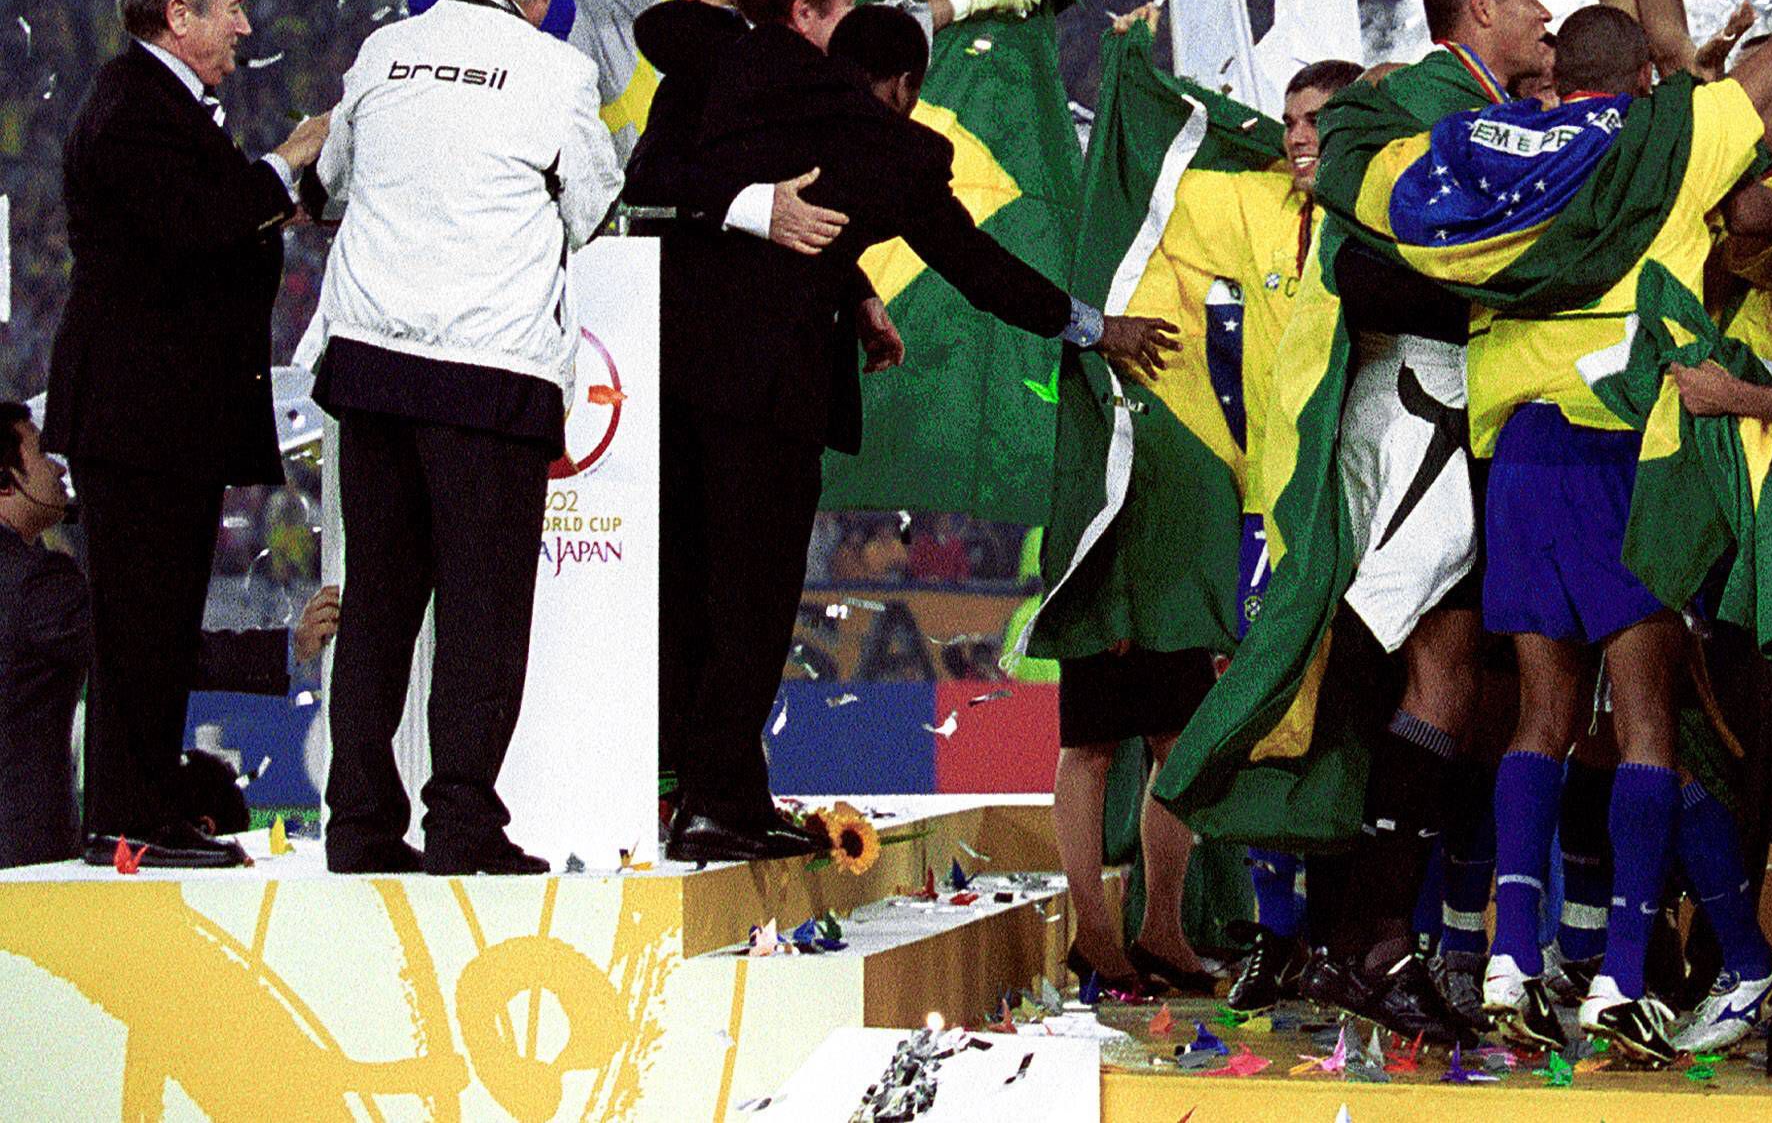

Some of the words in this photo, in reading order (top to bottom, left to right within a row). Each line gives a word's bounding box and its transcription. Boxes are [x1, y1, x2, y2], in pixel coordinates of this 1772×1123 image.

[388, 60, 508, 90] brasil
[544, 516, 583, 531] ORLD
[589, 516, 622, 532] CUP
[553, 536, 623, 577] JAPAN
